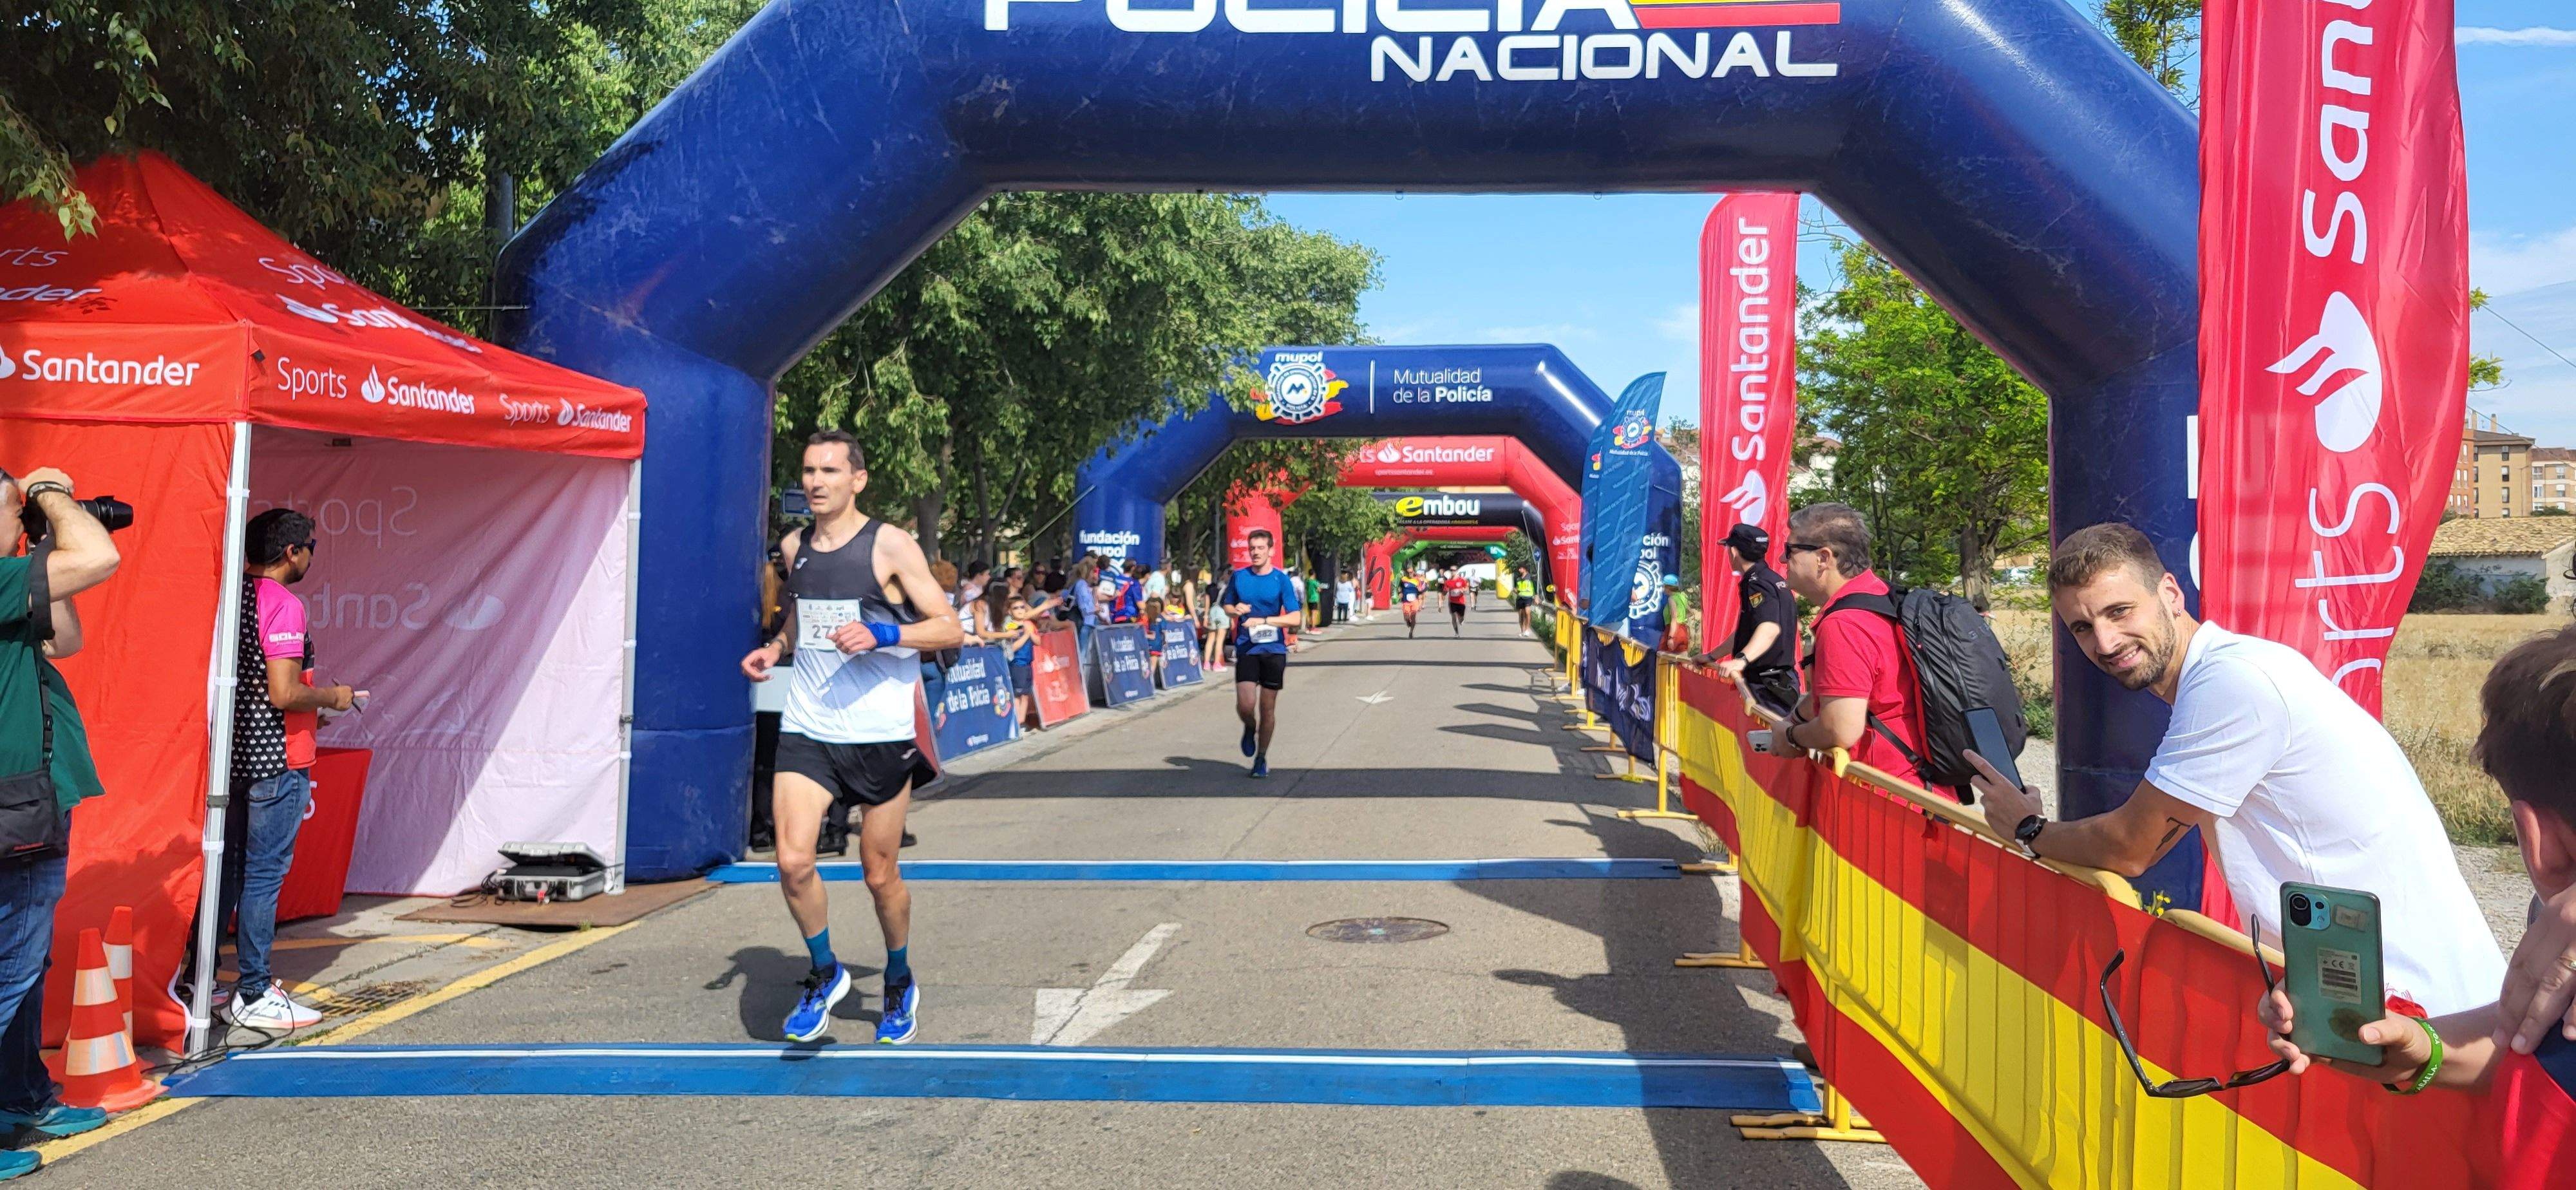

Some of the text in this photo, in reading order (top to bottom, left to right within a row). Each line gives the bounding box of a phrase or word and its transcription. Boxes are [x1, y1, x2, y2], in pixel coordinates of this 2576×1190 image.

[1370, 30, 1839, 82] NACIONAL
[1729, 216, 1771, 462] Santander
[22, 348, 200, 387] Santander
[1274, 350, 1324, 365] mupol
[278, 356, 475, 415] Sports Santander
[1393, 368, 1483, 384] Mutualidad
[1393, 385, 1494, 404] de la Policía
[499, 393, 632, 433] Sports Santander
[1402, 446, 1495, 464] Santander
[1395, 494, 1481, 517] embou
[1079, 530, 1141, 546] fundación
